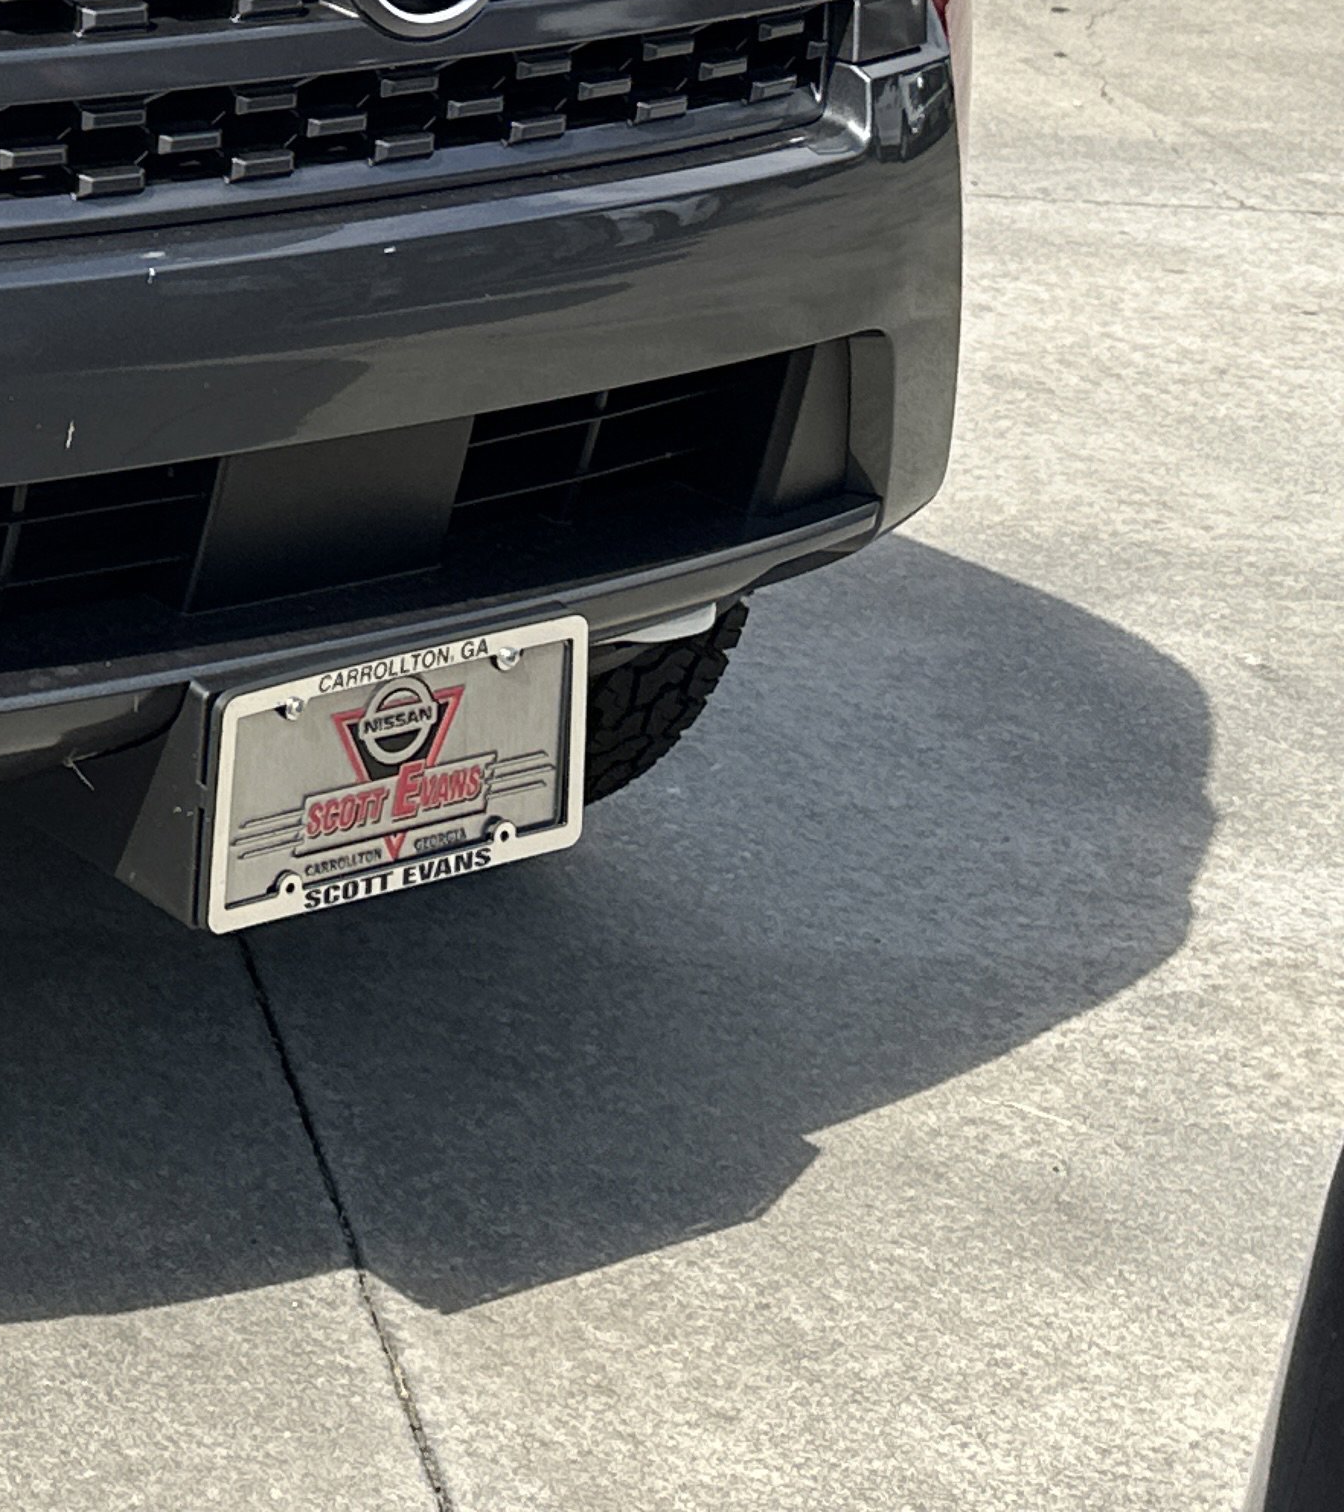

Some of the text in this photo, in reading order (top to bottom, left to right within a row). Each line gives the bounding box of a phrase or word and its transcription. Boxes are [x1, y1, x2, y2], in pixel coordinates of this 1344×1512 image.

[460, 638, 490, 670] GA
[362, 705, 433, 736] NISSAN
[305, 759, 484, 838] SCOTT EVANS
[303, 848, 383, 878] CARROLLTON
[303, 846, 492, 910] SCOTT EVANS
